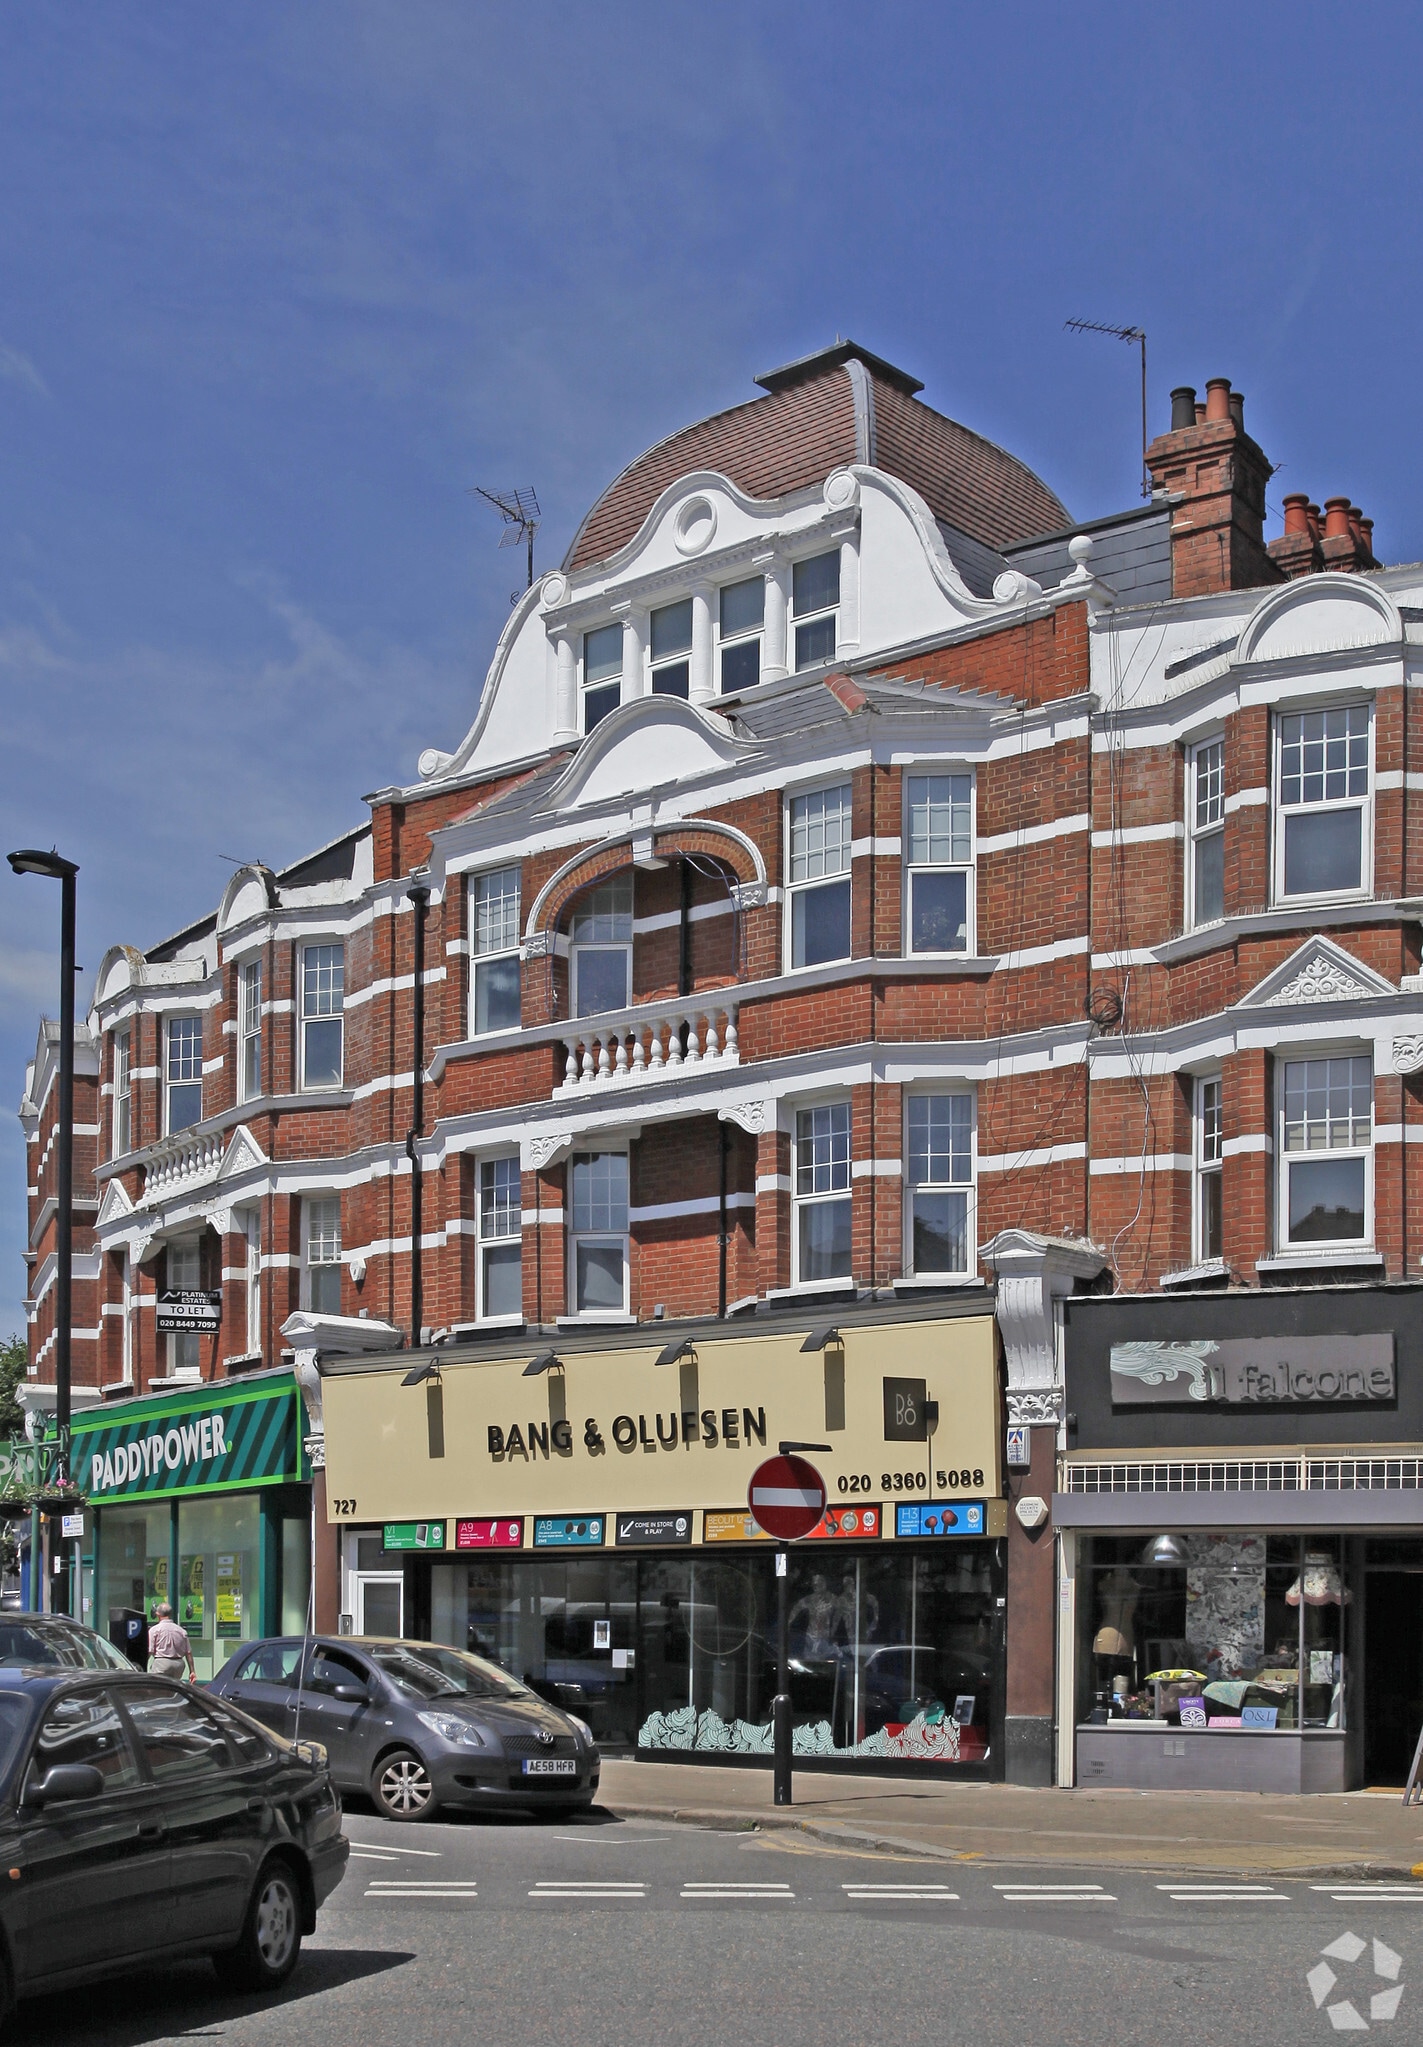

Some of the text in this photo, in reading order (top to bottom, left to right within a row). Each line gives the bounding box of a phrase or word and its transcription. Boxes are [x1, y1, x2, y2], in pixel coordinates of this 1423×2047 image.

[170, 1306, 206, 1315] TO LET
[176, 1320, 196, 1328] 8449
[197, 1321, 217, 1329] 7099
[1239, 1360, 1393, 1401] falcone
[487, 1406, 766, 1454] BANG & OLUFSEN
[837, 1468, 985, 1493] 020 8360 5088
[333, 1499, 356, 1515] 727
[902, 1507, 918, 1519] H3
[460, 1522, 474, 1533] A9
[538, 1520, 552, 1531] A8
[129, 1621, 138, 1635] P
[529, 1761, 574, 1772] AE58 HFR
